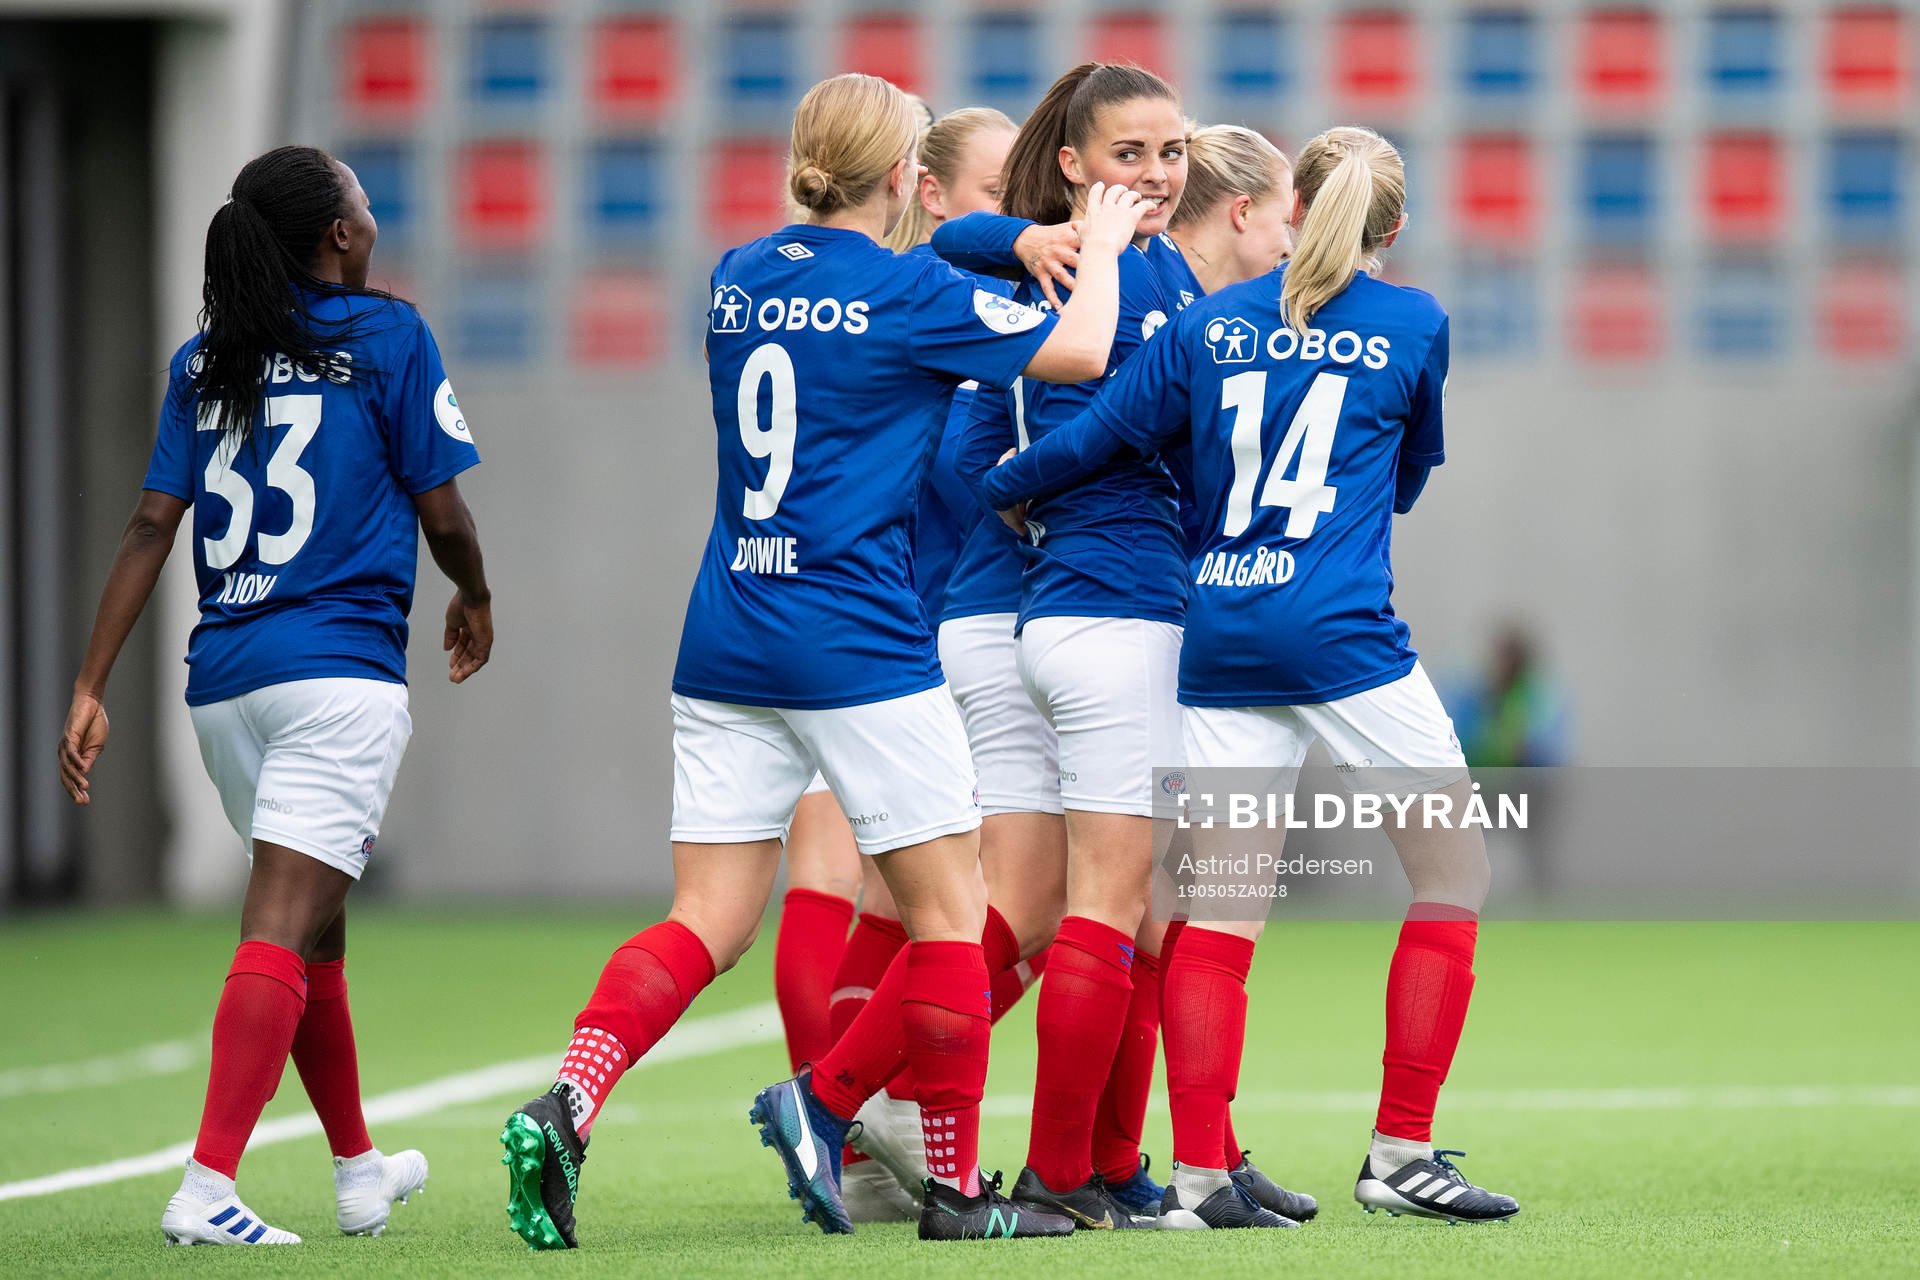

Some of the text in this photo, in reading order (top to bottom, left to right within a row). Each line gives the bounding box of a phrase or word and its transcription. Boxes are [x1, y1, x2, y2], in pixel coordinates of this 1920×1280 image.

[758, 297, 869, 334] OBOS
[1266, 327, 1391, 370] OBOS
[737, 343, 797, 521] 9
[1221, 370, 1349, 539] 14
[196, 394, 322, 570] 33
[730, 537, 798, 574] DOWIE
[1195, 545, 1295, 587] DALGÅRD
[848, 813, 889, 827] mbro
[543, 1120, 565, 1153] new
